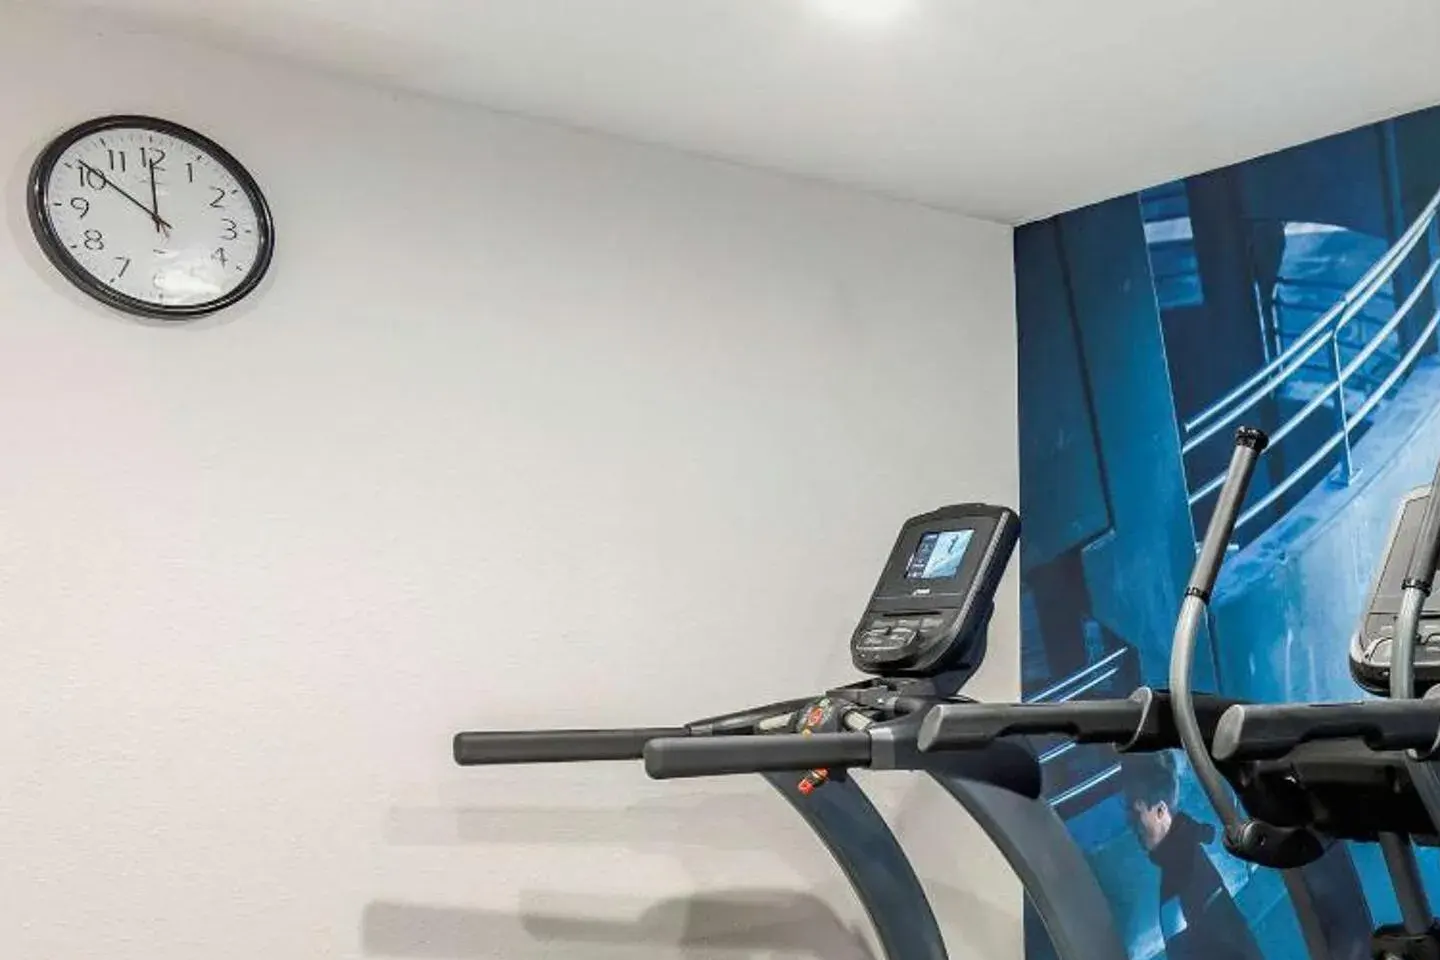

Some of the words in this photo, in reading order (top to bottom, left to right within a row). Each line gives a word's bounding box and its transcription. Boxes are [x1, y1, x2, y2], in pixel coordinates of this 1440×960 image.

[107, 149, 126, 172] 11
[139, 147, 165, 172] 12
[78, 165, 106, 190] 10
[186, 162, 194, 183] 1
[70, 197, 90, 219] 9
[209, 186, 227, 208] 2
[84, 229, 105, 251] 8
[219, 218, 238, 240] 3
[114, 256, 131, 278] 7
[211, 247, 229, 268] 4
